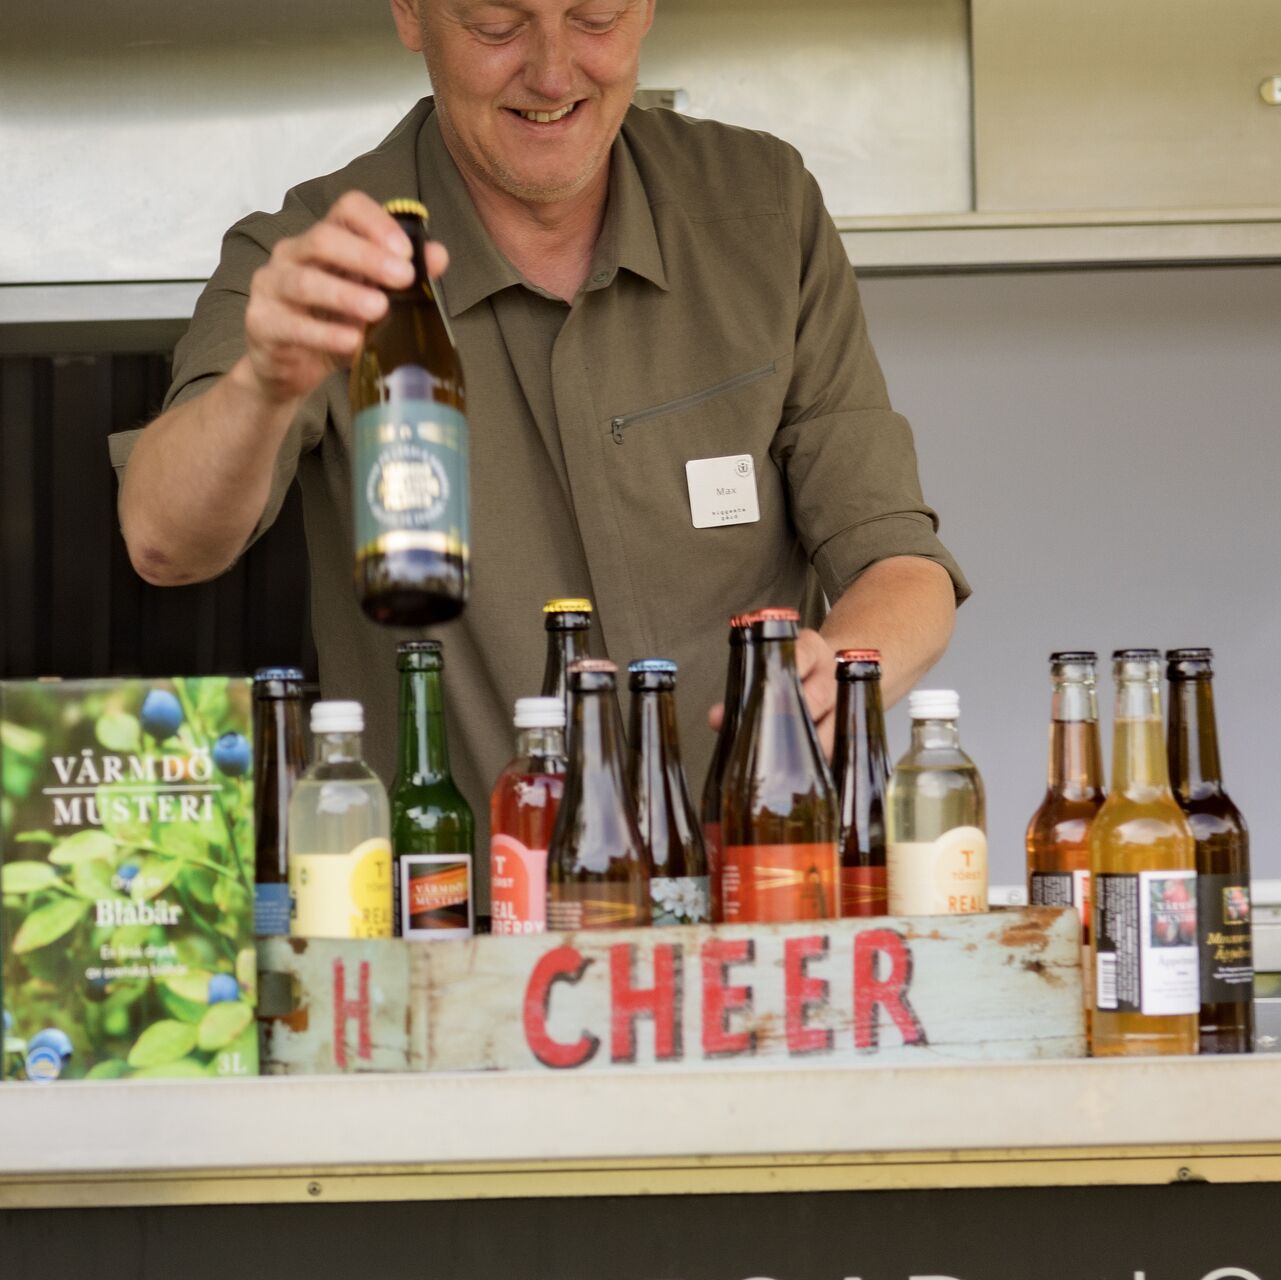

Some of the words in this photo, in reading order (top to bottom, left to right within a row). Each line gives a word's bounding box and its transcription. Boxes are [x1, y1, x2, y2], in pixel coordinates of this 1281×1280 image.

[51, 747, 213, 784] VÄRMDÖ
[52, 795, 213, 825] MUSTERI
[95, 899, 184, 927] Blåbär
[332, 958, 372, 1067] H
[523, 926, 928, 1068] CHEER
